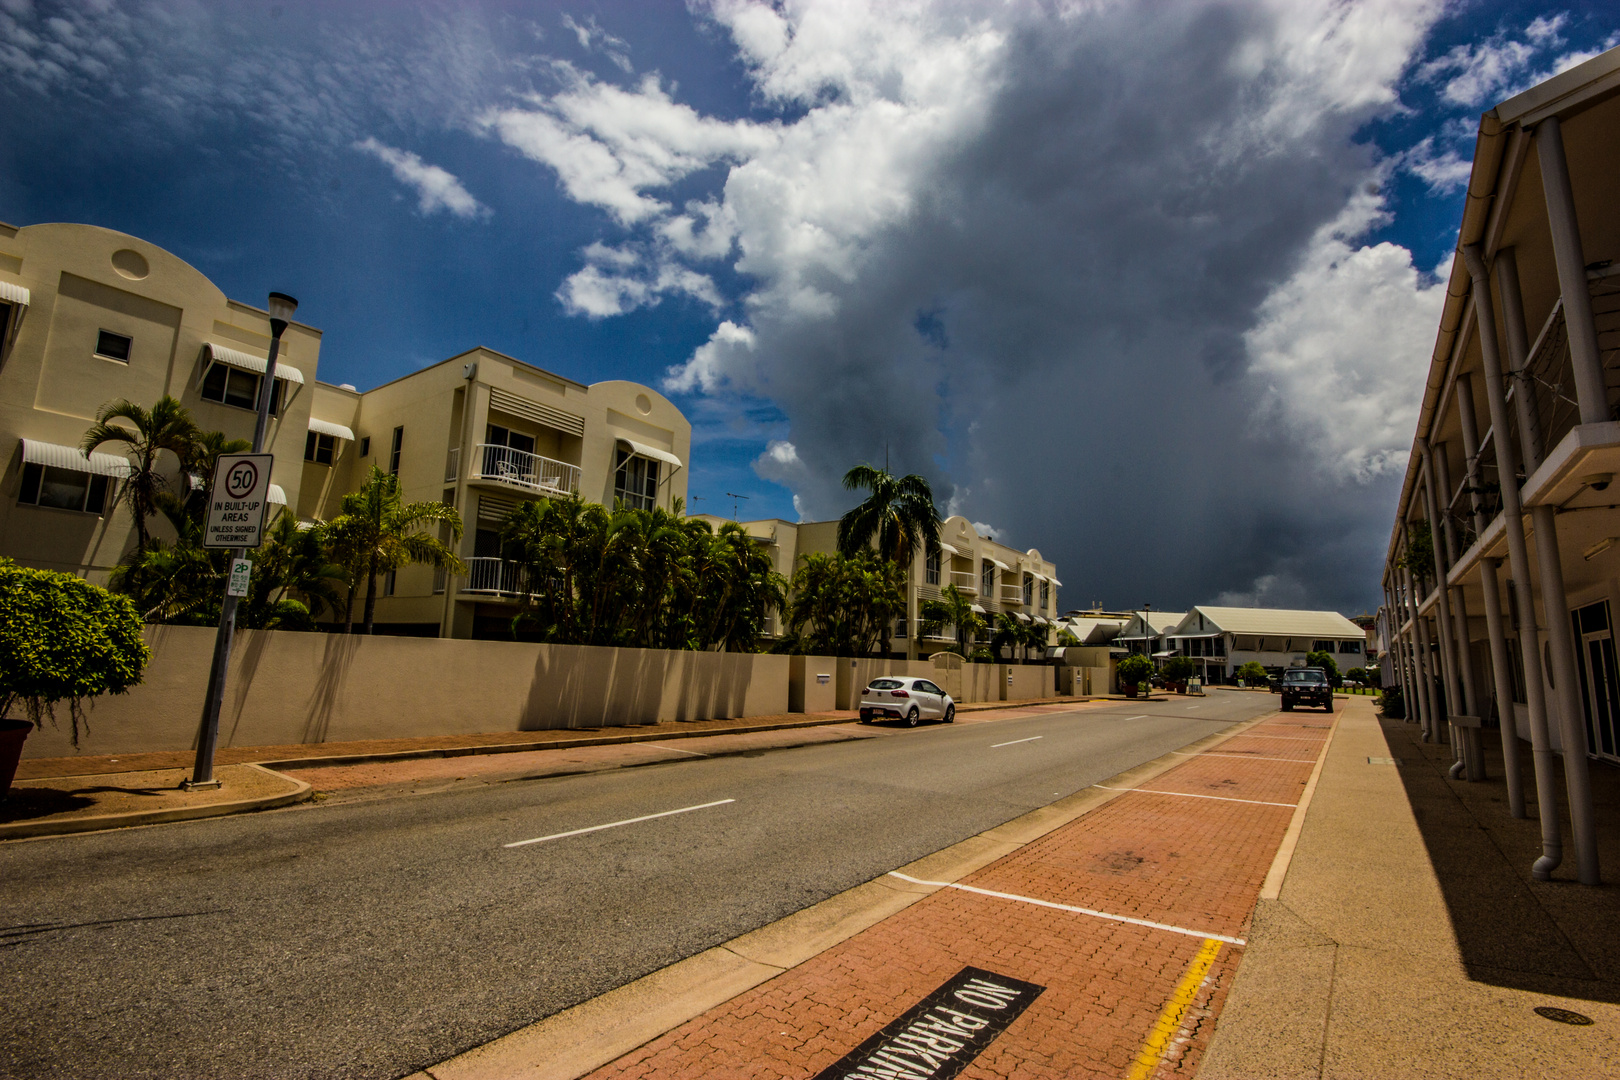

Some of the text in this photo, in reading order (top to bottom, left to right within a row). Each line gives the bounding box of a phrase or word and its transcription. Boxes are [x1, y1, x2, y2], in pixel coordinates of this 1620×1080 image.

[231, 470, 252, 489] 50
[214, 501, 259, 511] IN BUILT-UP
[221, 513, 249, 522] AREAS
[210, 525, 256, 533] UNLESS SIGNED
[215, 534, 248, 542] OTHERWISE
[234, 563, 248, 573] 2P
[953, 977, 1021, 1010] NO
